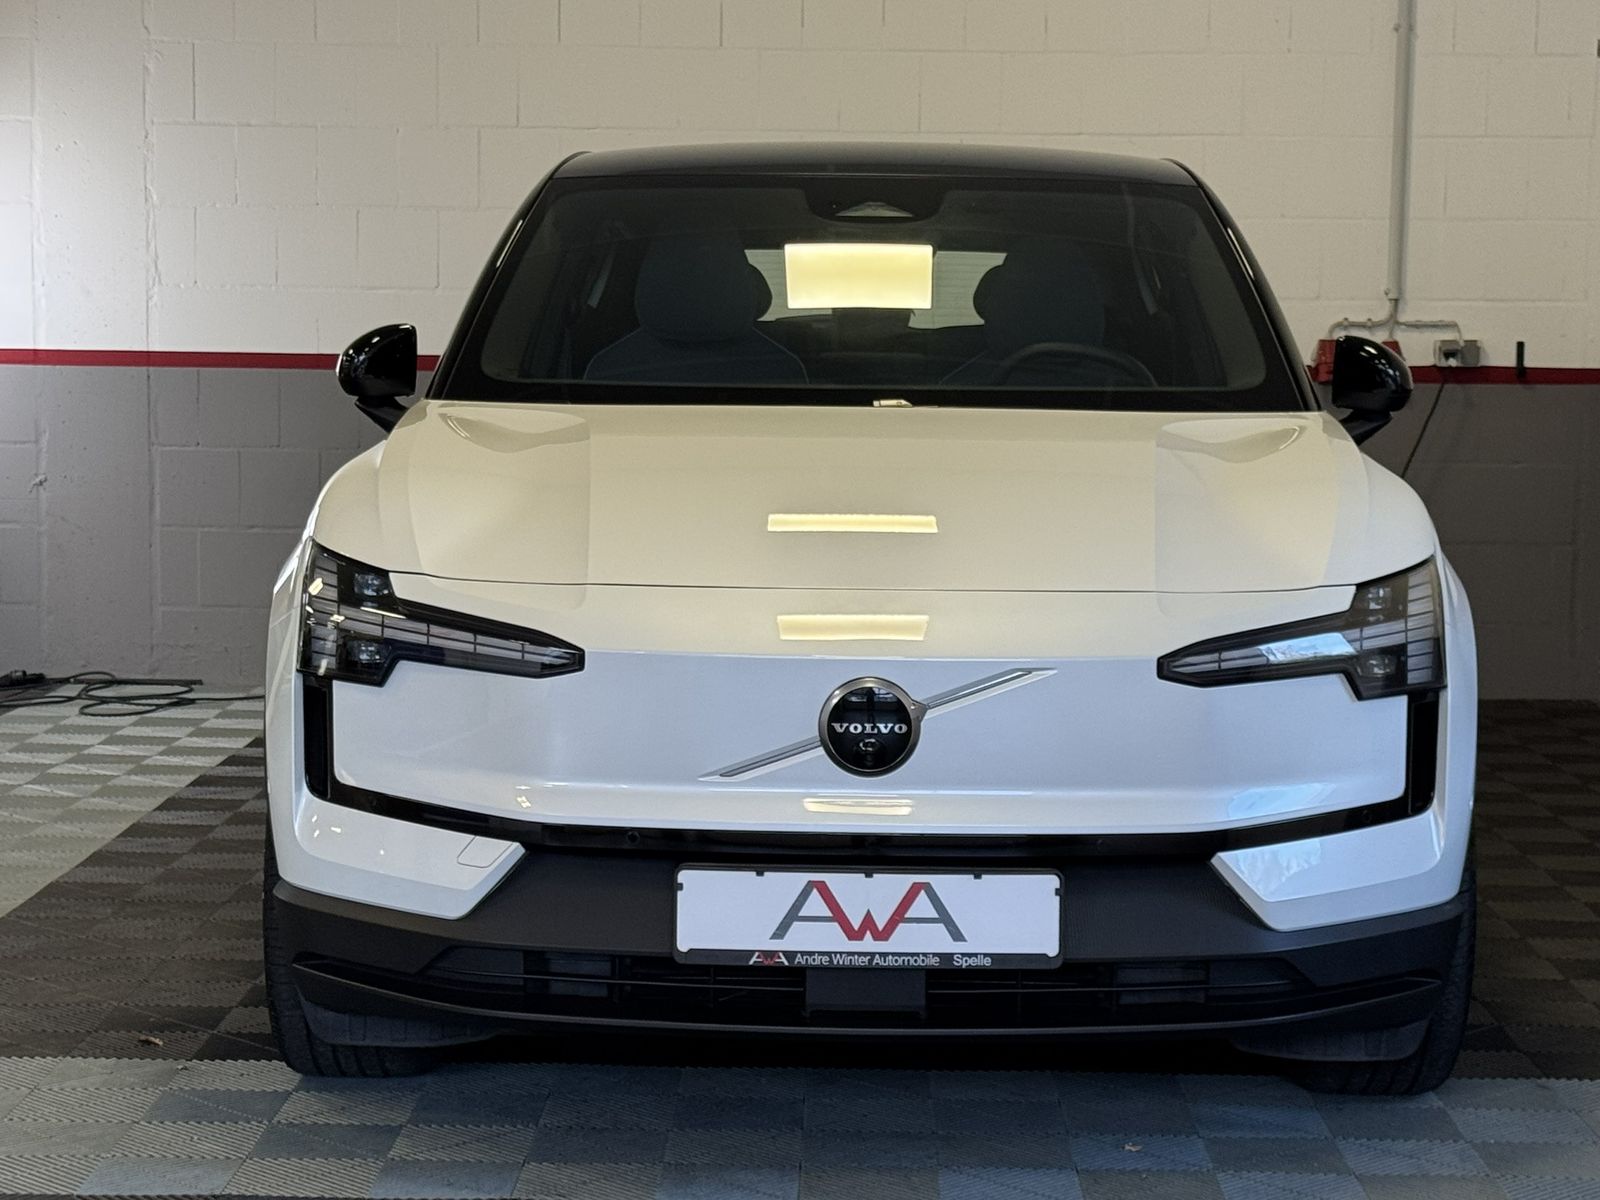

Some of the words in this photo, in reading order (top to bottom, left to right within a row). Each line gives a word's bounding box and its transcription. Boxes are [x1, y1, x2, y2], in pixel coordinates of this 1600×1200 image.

[831, 723, 908, 734] VOLVO
[794, 953, 829, 965] Andre
[832, 953, 871, 966] Winter
[872, 954, 940, 966] Automobile
[953, 954, 992, 968] Spelle
